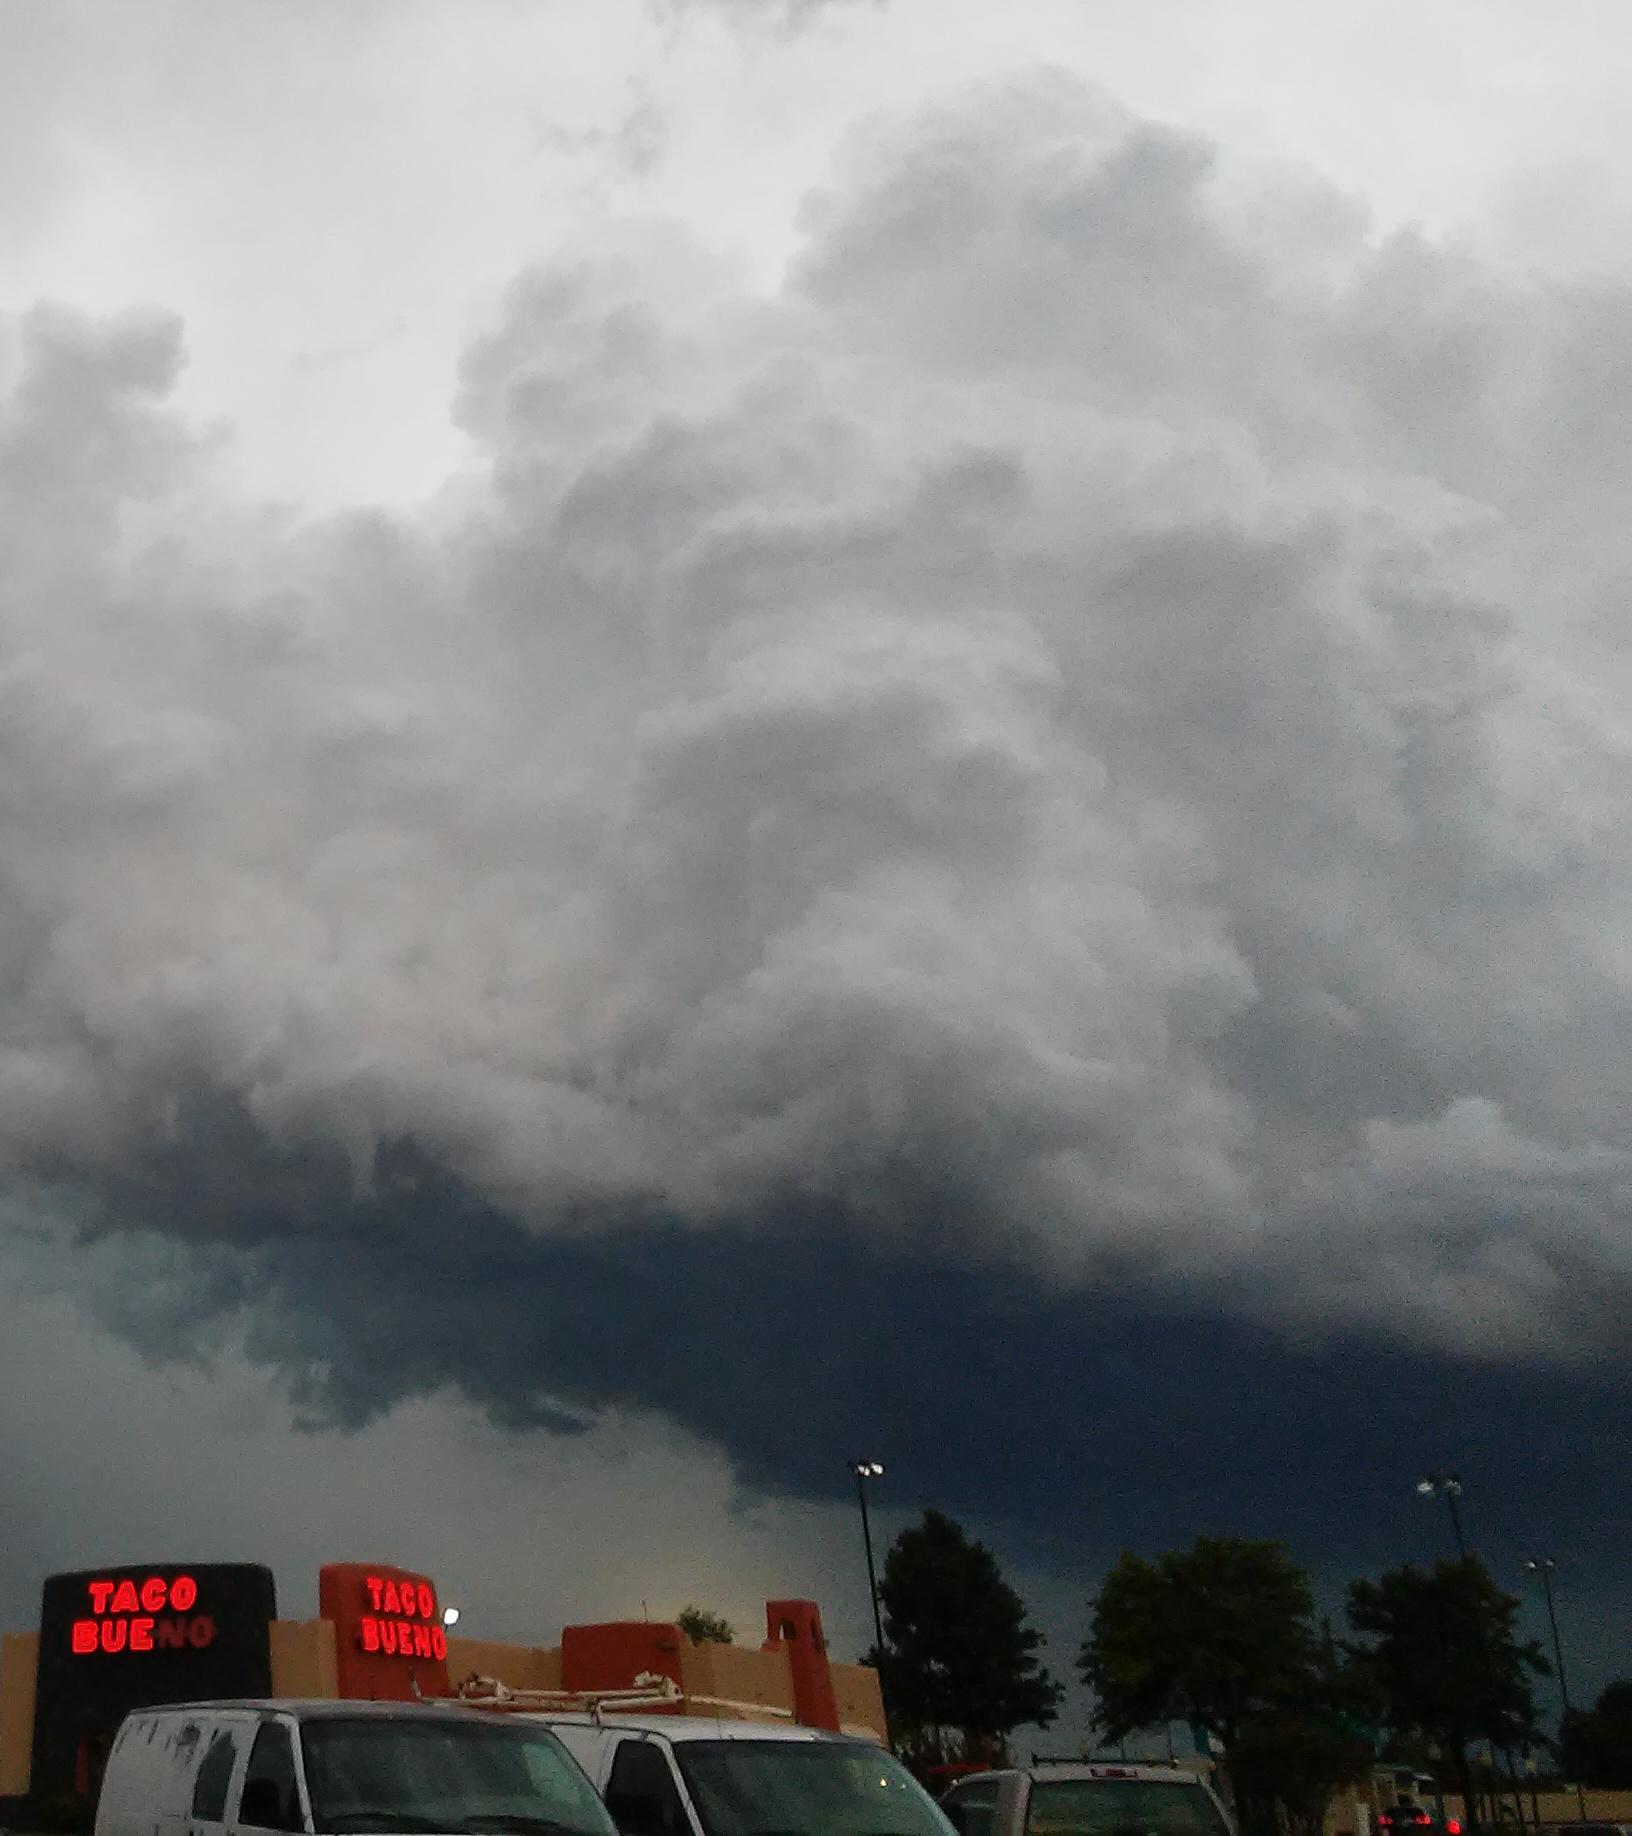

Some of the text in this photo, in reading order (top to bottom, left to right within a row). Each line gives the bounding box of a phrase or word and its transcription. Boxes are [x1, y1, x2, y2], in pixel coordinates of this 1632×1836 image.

[89, 1575, 197, 1614] TACO
[366, 1576, 433, 1618] TACO
[72, 1616, 214, 1653] BUENO
[362, 1616, 447, 1661] BUENO
